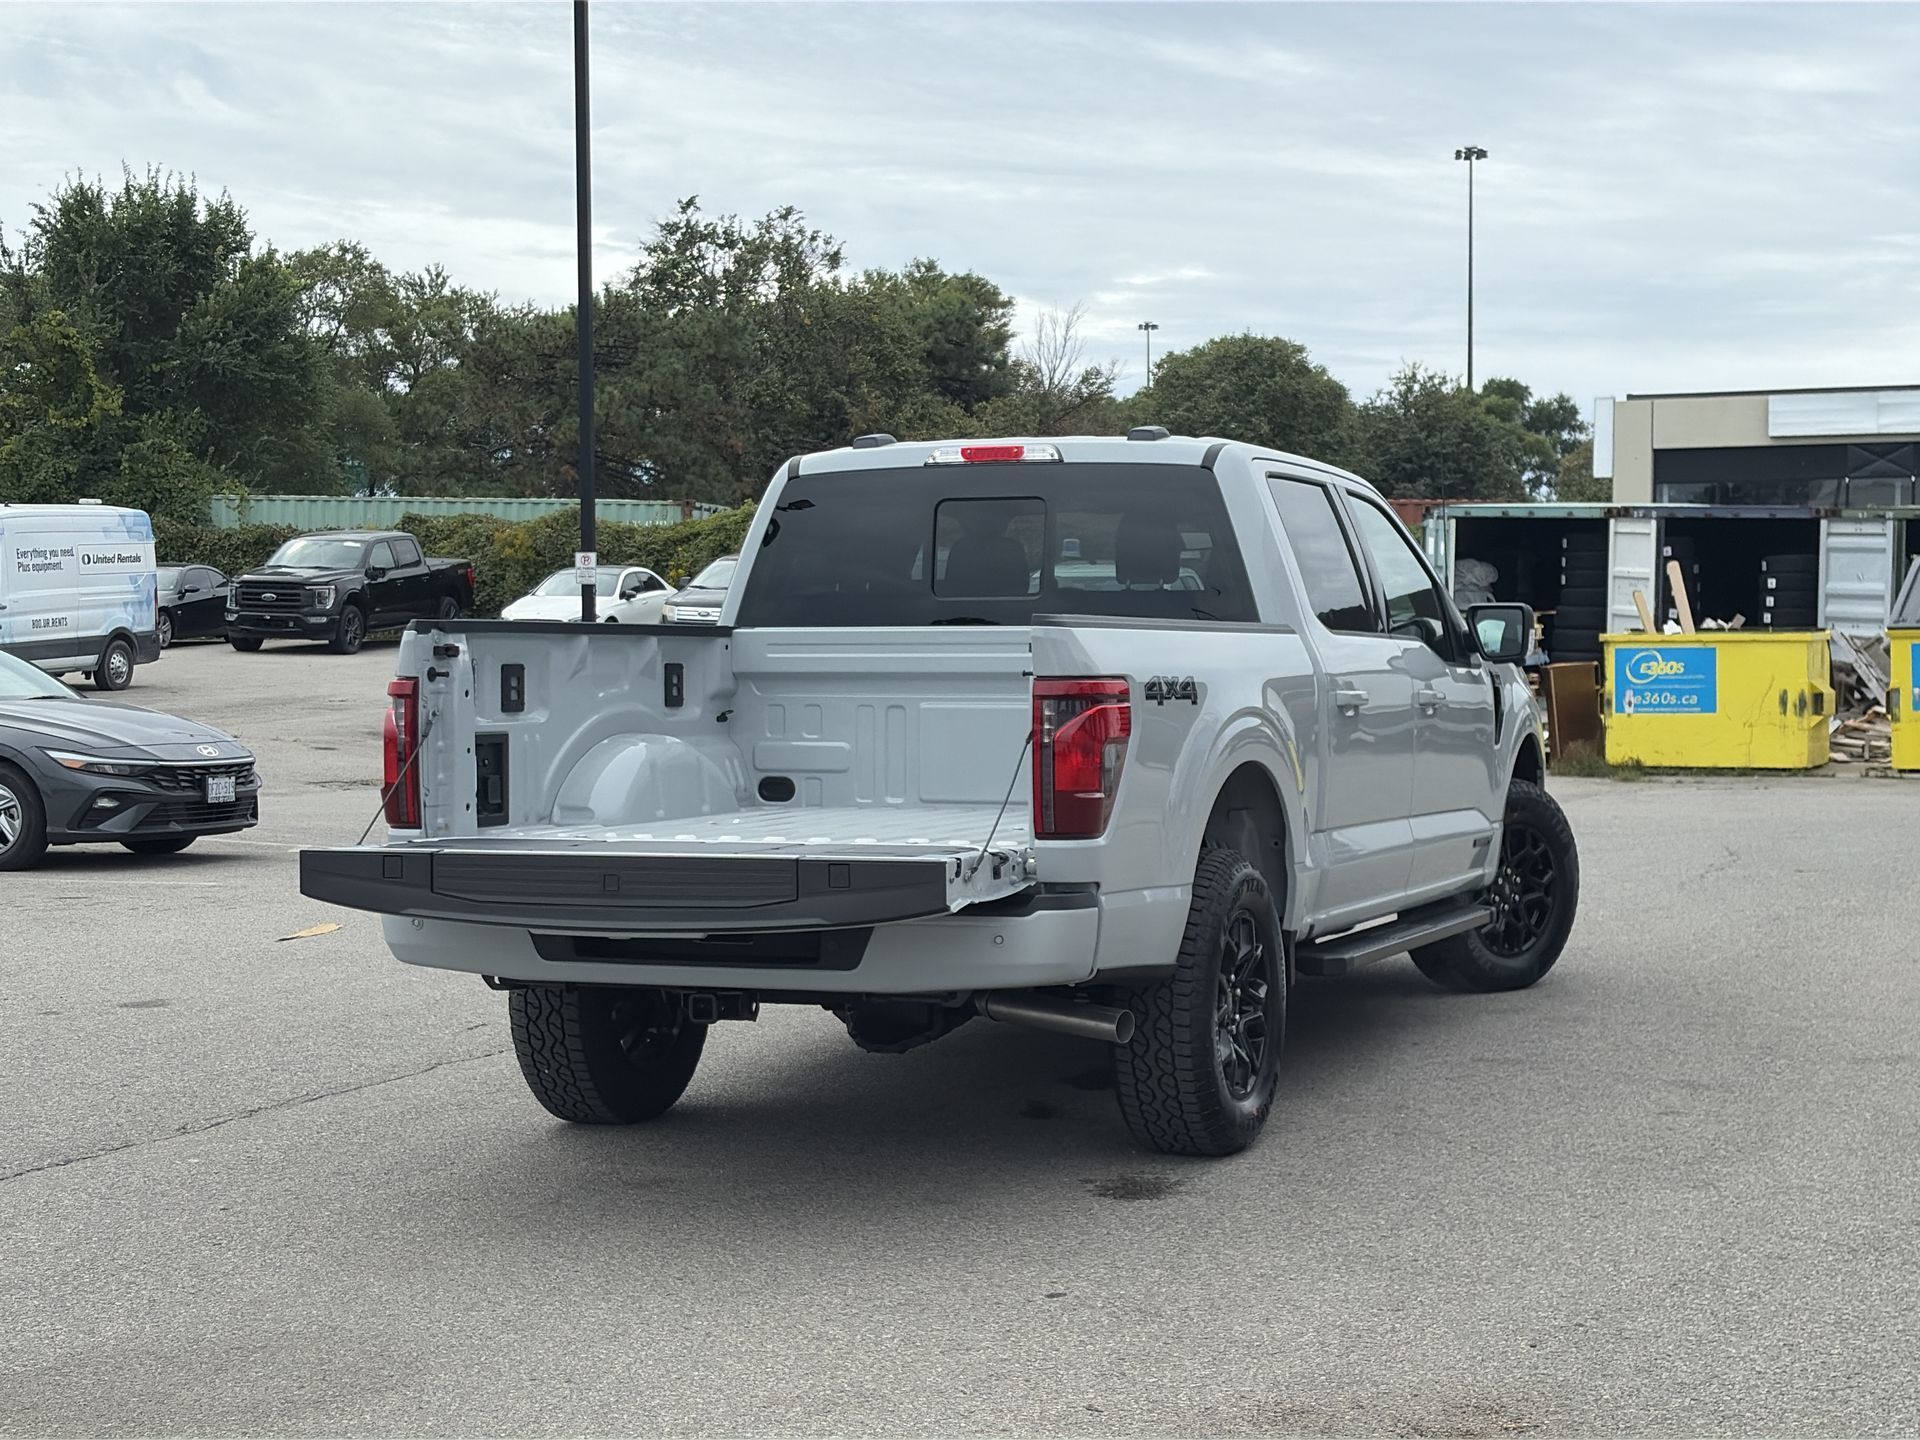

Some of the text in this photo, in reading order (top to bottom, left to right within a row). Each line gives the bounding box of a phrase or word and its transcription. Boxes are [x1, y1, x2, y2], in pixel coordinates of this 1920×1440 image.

[16, 548, 48, 561] Everything
[48, 550, 59, 560] you
[92, 553, 142, 564] United Rentals
[17, 561, 63, 573] Plus equipment.
